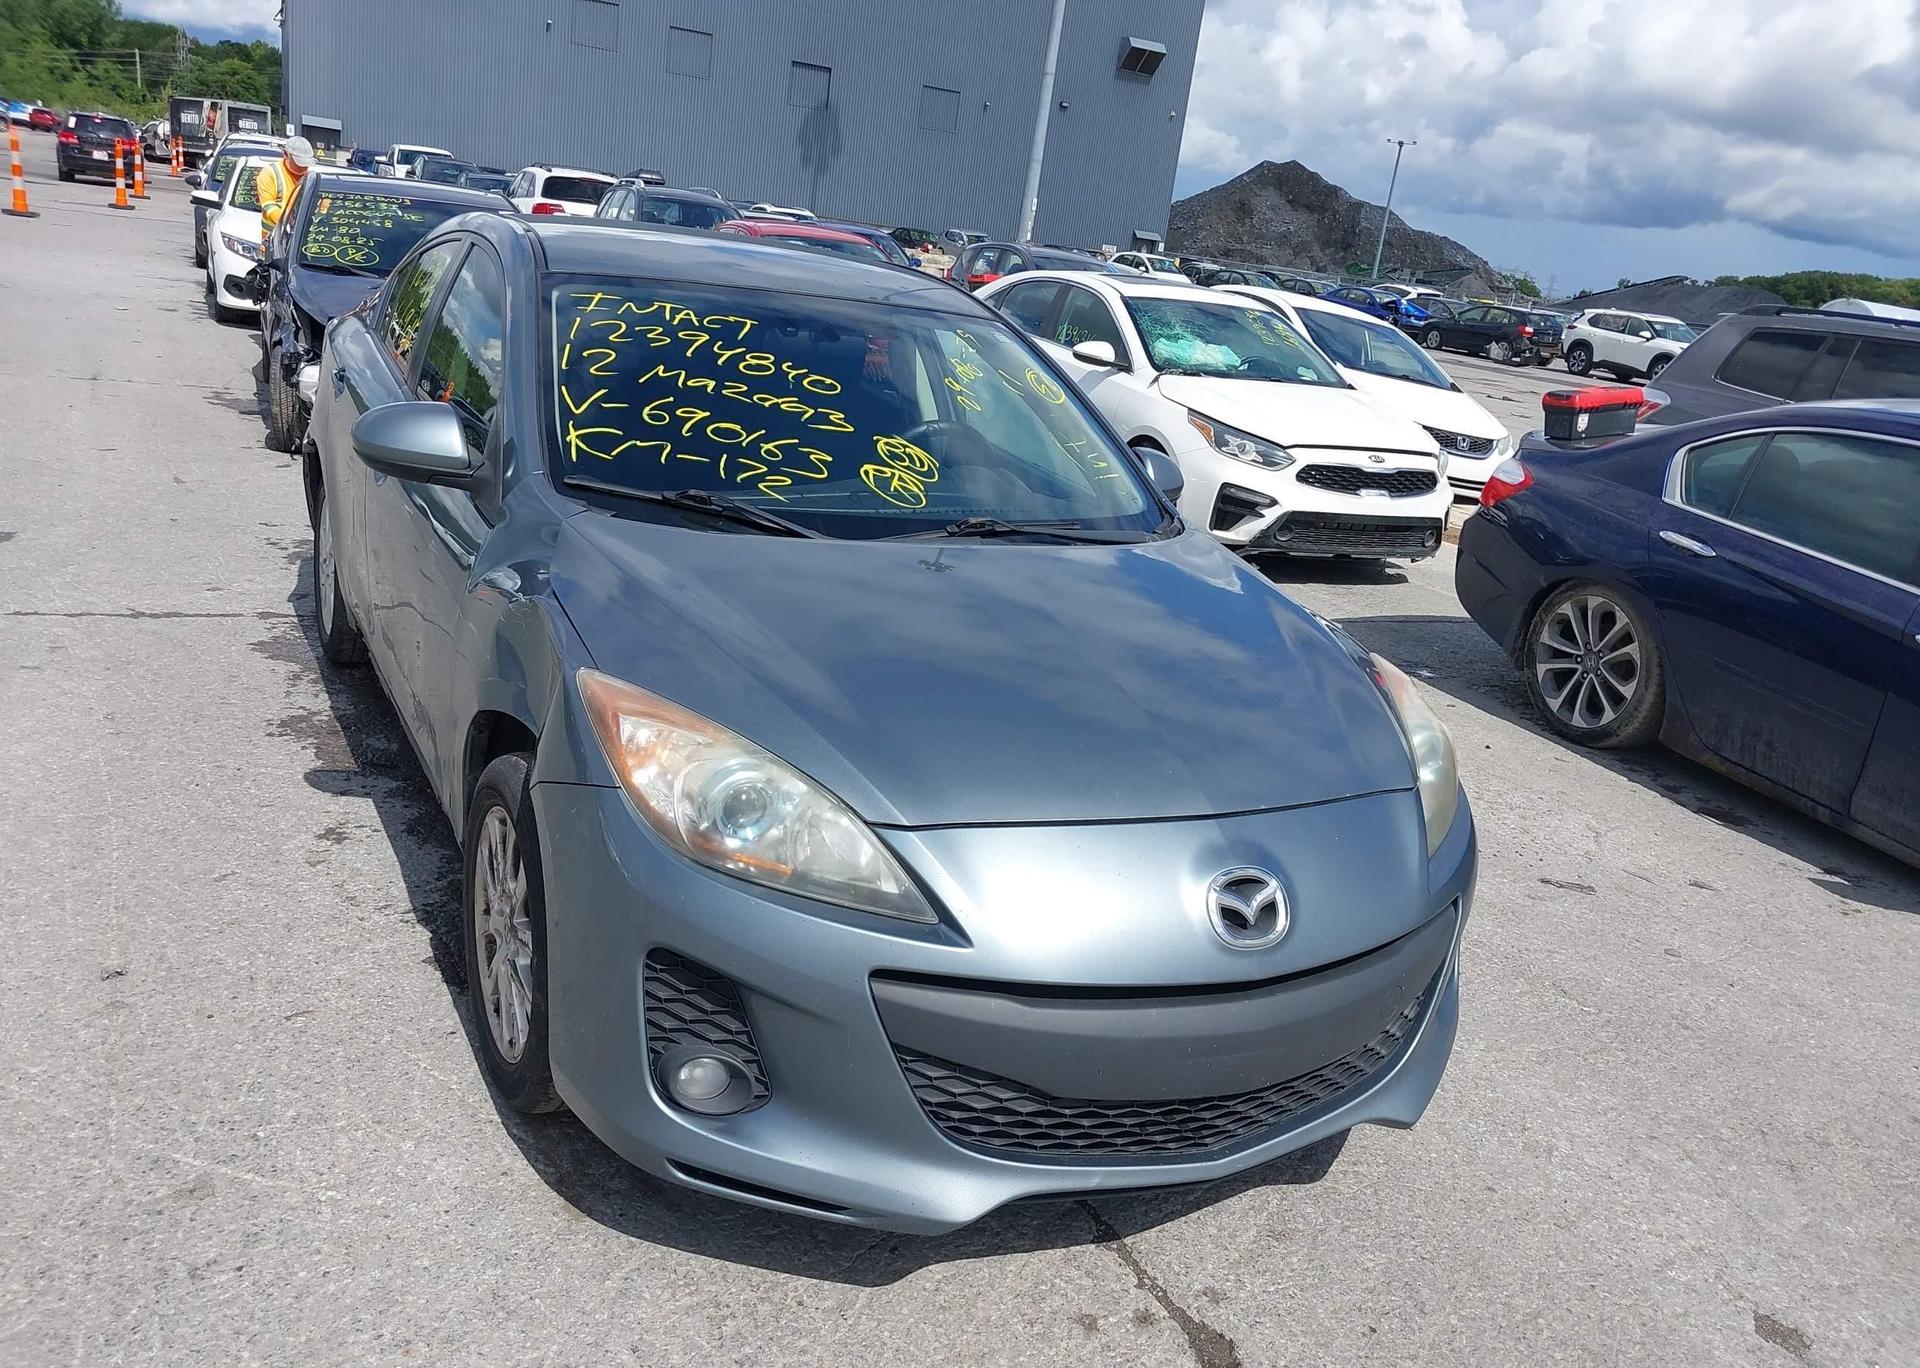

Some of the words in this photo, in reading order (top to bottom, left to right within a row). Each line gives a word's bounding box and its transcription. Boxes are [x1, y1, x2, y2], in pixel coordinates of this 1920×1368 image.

[569, 292, 759, 341] INTACT
[561, 334, 621, 376] 12
[569, 317, 842, 395] 12394840
